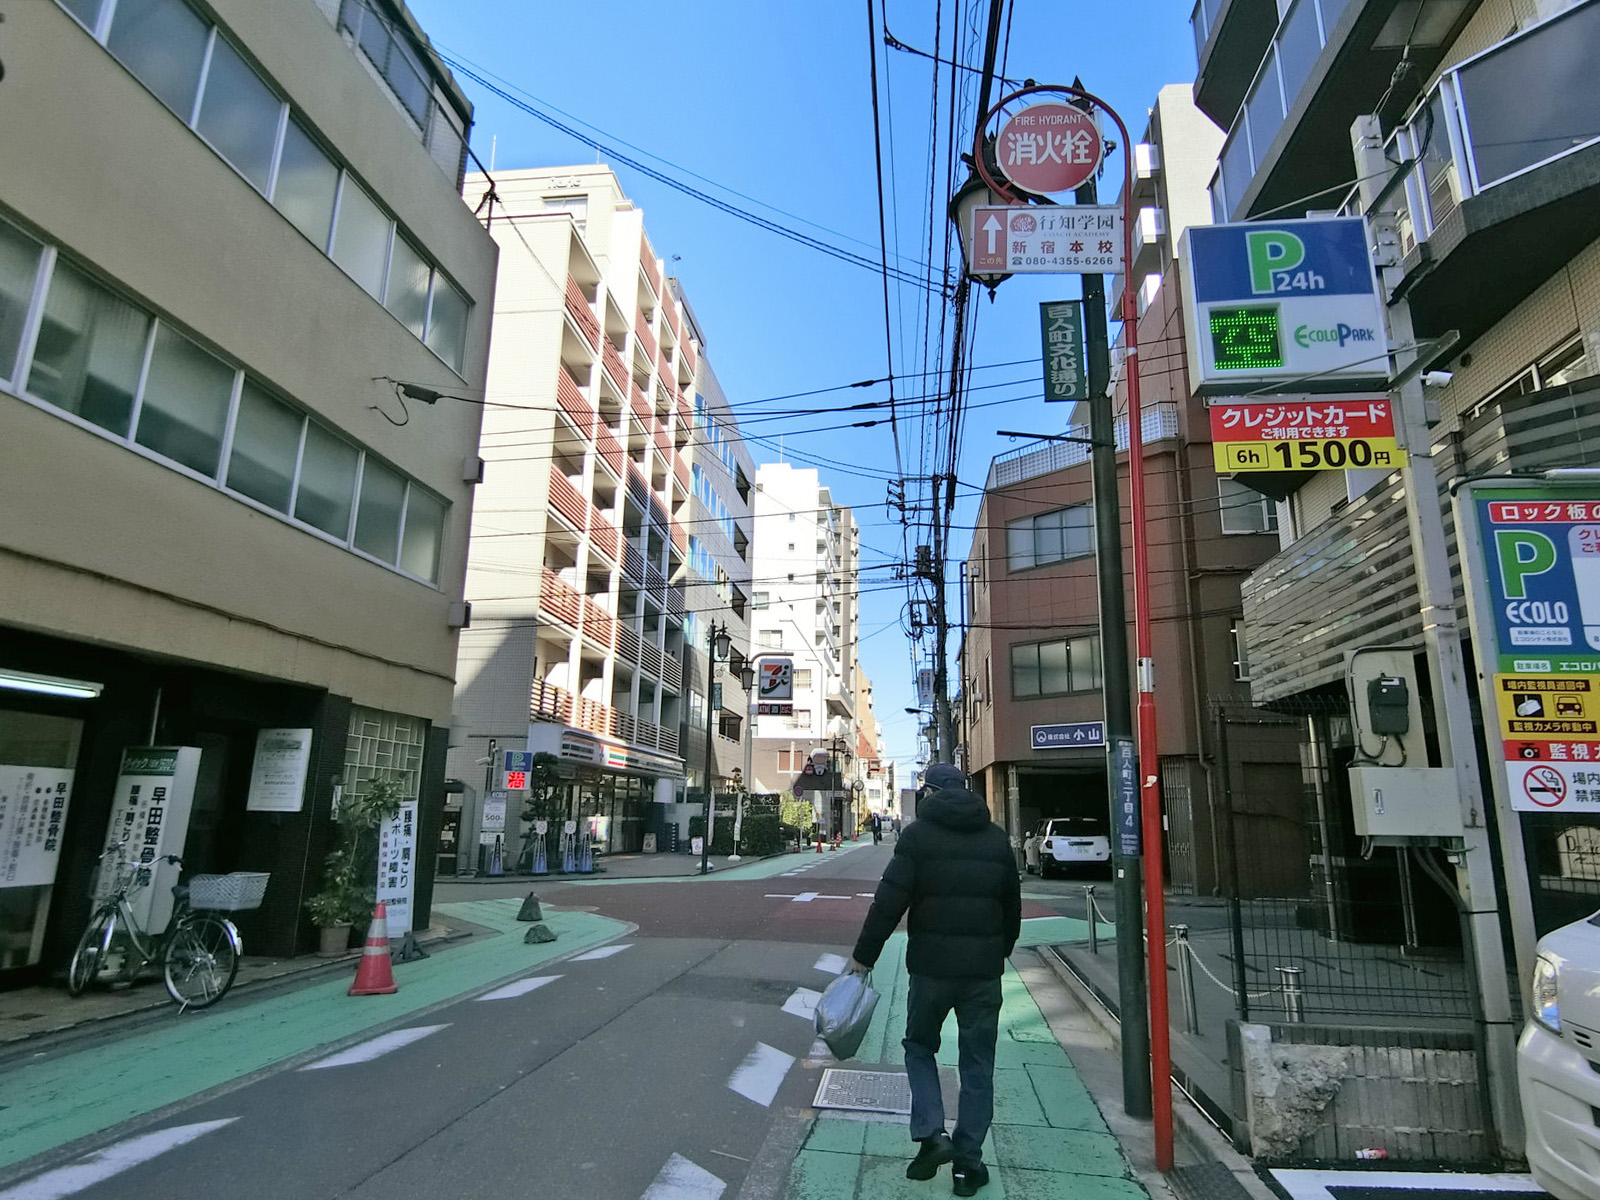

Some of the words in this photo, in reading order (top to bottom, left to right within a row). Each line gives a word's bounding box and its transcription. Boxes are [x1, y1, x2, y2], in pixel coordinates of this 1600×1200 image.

[1015, 115, 1036, 126] FIRE
[1038, 114, 1083, 125] HYDRANT
[1007, 129, 1093, 166] 消火栓
[1039, 215, 1115, 231] 行知学园
[1012, 240, 1114, 255] 新宿本校
[979, 257, 1004, 266] この先
[1025, 257, 1114, 266] 080-4355-6266
[1245, 230, 1306, 295] P
[1276, 270, 1326, 292] 24h
[1047, 304, 1078, 397] 百人町文化通り
[1210, 310, 1283, 371] 空
[1221, 402, 1387, 429] クレジットカード
[1261, 426, 1350, 440] ご利用できます
[1236, 447, 1261, 464] 6h
[1494, 529, 1557, 599] P
[1505, 601, 1569, 624] ECOLO
[1507, 680, 1586, 691] 場内監視員巡回中
[1073, 728, 1100, 741] 小山
[1513, 721, 1592, 732] 監視カメラ作動中
[507, 771, 526, 790] 満
[1572, 771, 1600, 786] 場内
[44, 782, 67, 852] 早田整骨院
[136, 786, 167, 887] 早田整骨院
[388, 810, 401, 888] スポーツ障害
[400, 809, 413, 889] 腰痛・肩こり
